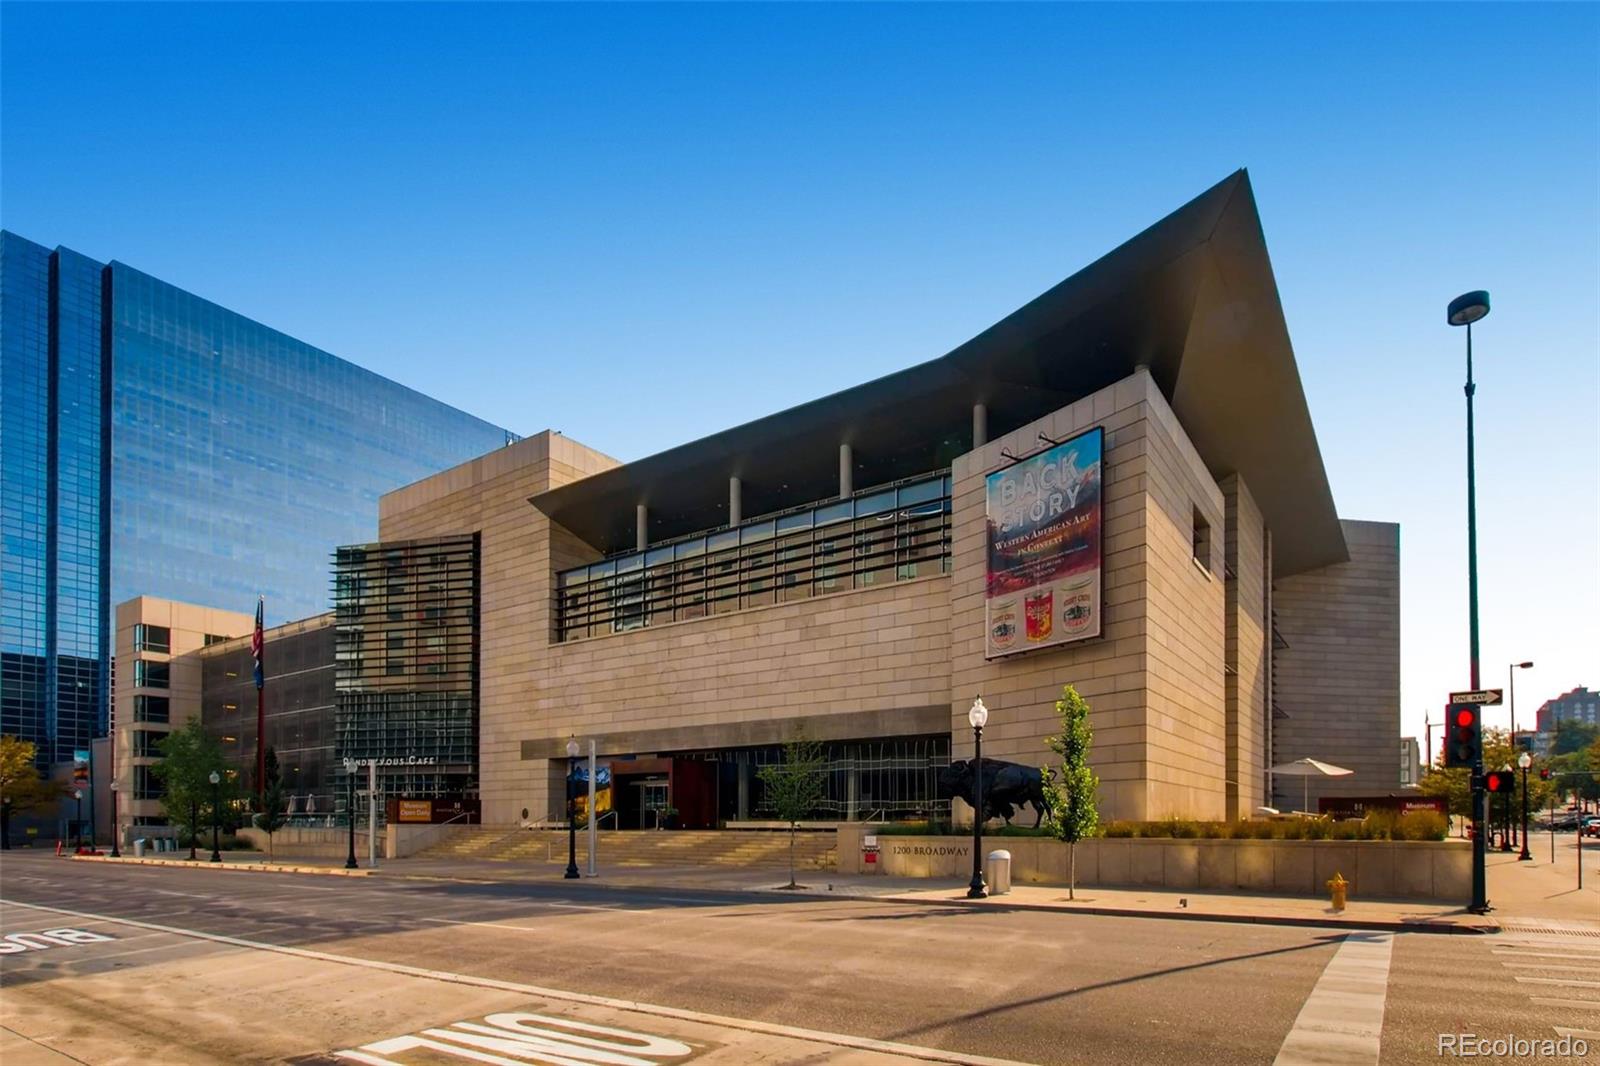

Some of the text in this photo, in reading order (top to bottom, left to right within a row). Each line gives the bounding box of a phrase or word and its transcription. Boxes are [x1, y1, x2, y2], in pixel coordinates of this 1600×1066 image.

[1001, 452, 1079, 505] BACK
[1001, 485, 1080, 532] STORY
[1031, 519, 1073, 538] AMERICAN
[1073, 513, 1091, 526] ART
[343, 757, 405, 766] RNDVOUS
[893, 846, 969, 856] 1200 BROADWAY
[334, 1012, 692, 1066] ONL
